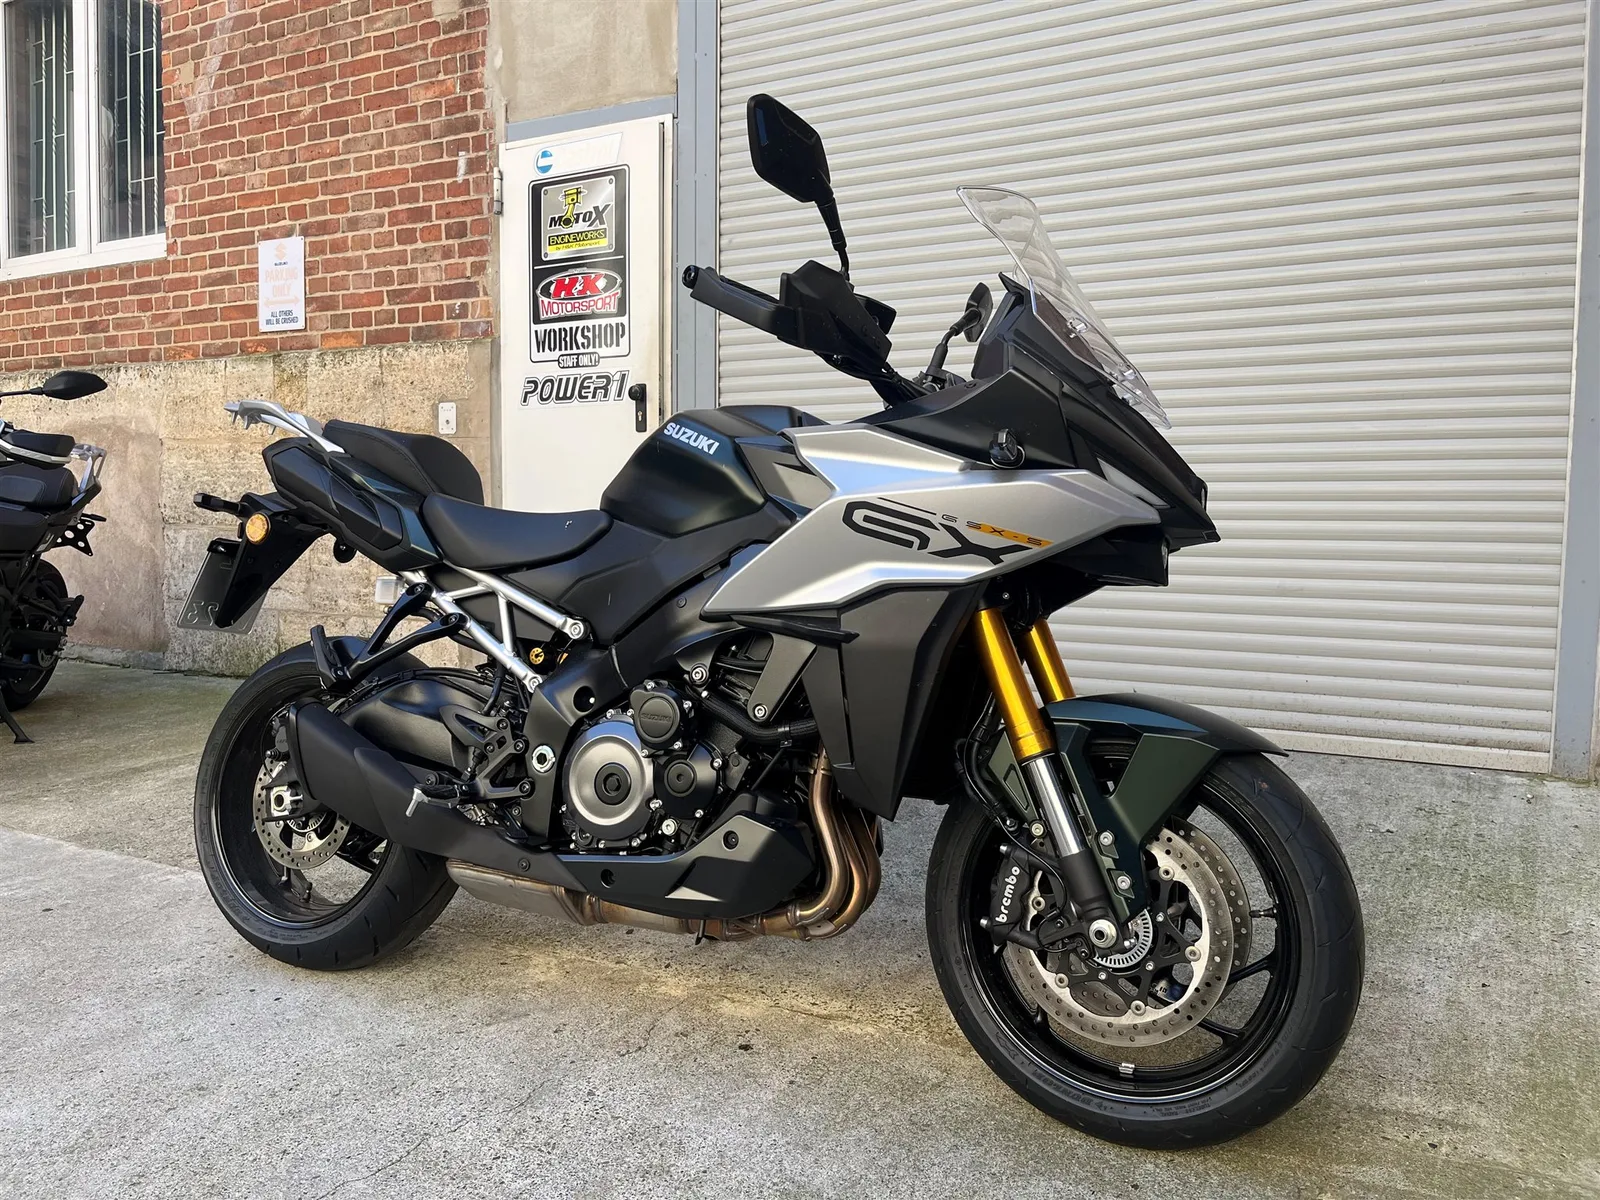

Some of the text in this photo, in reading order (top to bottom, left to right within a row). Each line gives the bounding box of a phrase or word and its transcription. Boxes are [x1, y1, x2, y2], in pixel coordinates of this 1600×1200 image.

[550, 230, 605, 245] ENGINEWORKS
[265, 267, 298, 283] PARKING
[272, 283, 292, 297] ONLY
[541, 292, 619, 317] MOTORSPORT
[279, 309, 293, 317] OTHERS
[281, 316, 299, 325] CRUSHED
[534, 322, 626, 353] WORKSHOP
[559, 353, 599, 368] STAFF ONLY!
[522, 372, 628, 404] POWER1
[663, 422, 720, 455] SUZUKI
[995, 866, 1020, 923] brembo
